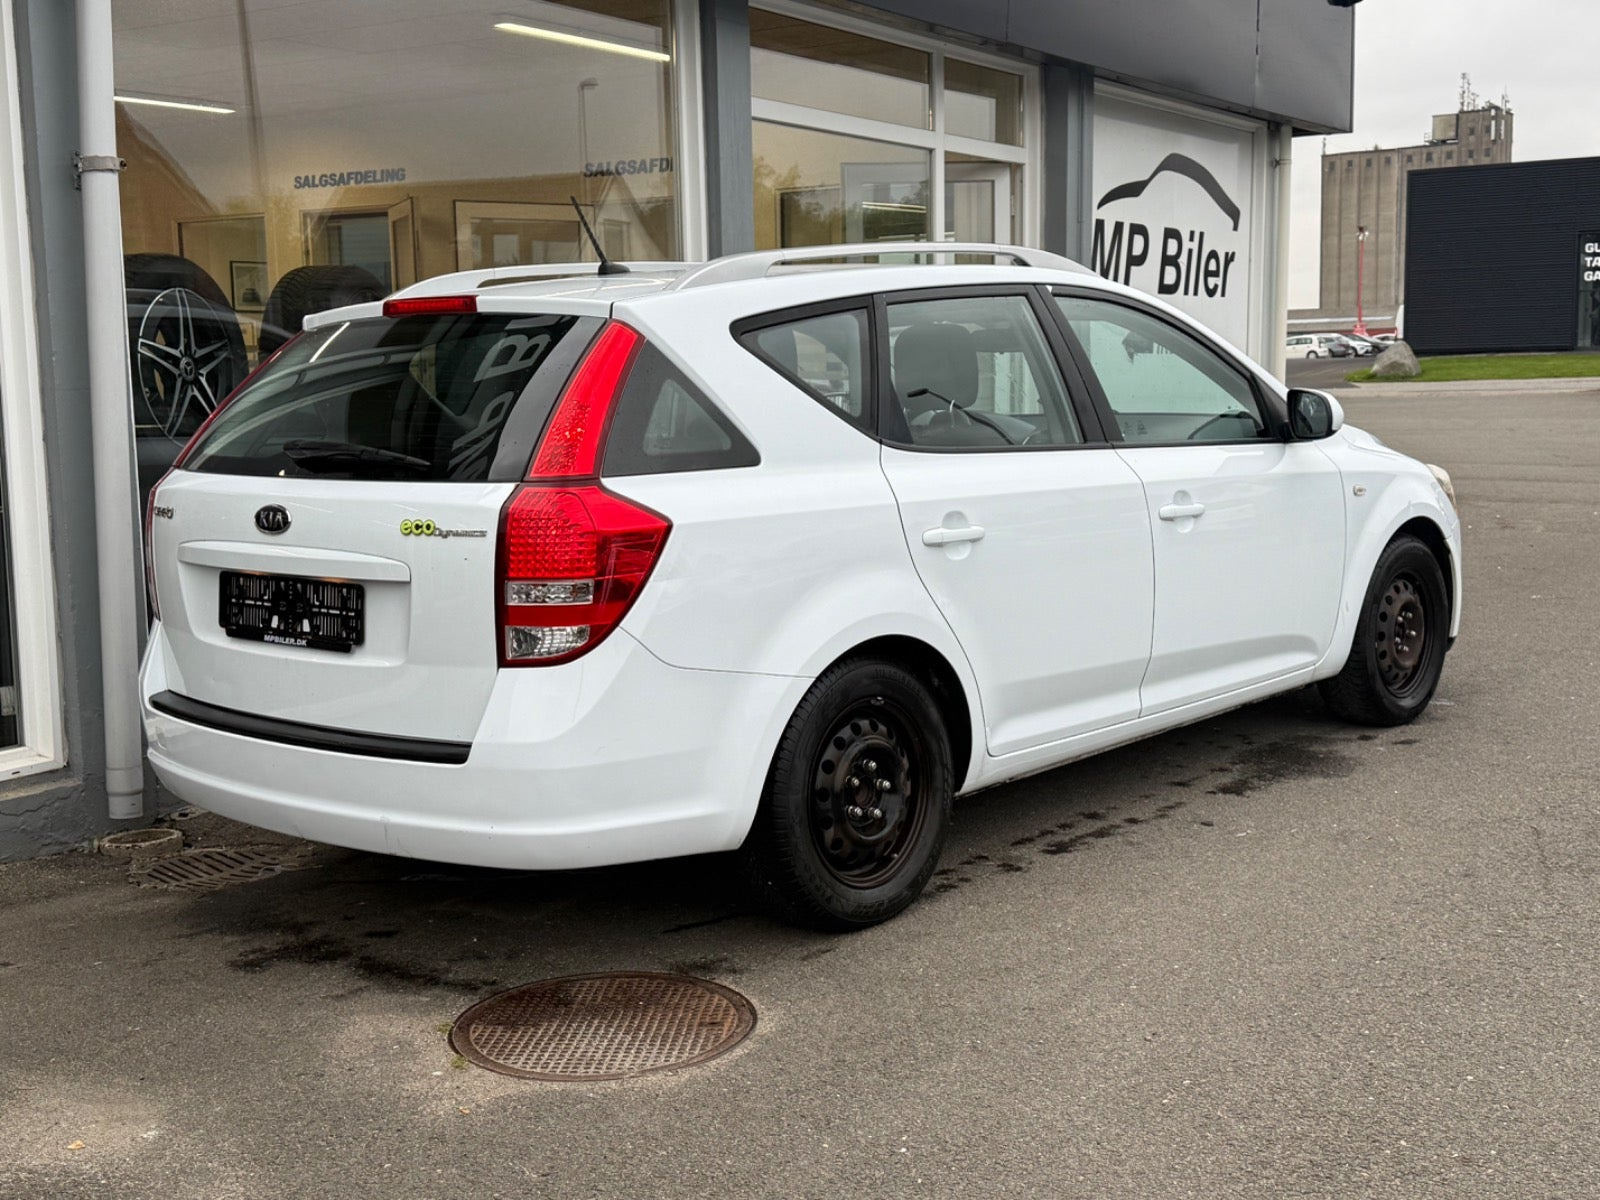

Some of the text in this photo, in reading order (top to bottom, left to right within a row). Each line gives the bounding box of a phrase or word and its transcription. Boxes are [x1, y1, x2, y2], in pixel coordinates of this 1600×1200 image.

[294, 167, 406, 190] SALGSAFDELING
[1091, 218, 1236, 298] MP Biler
[260, 510, 284, 528] KIA
[263, 634, 308, 647] MPBILER.DK
